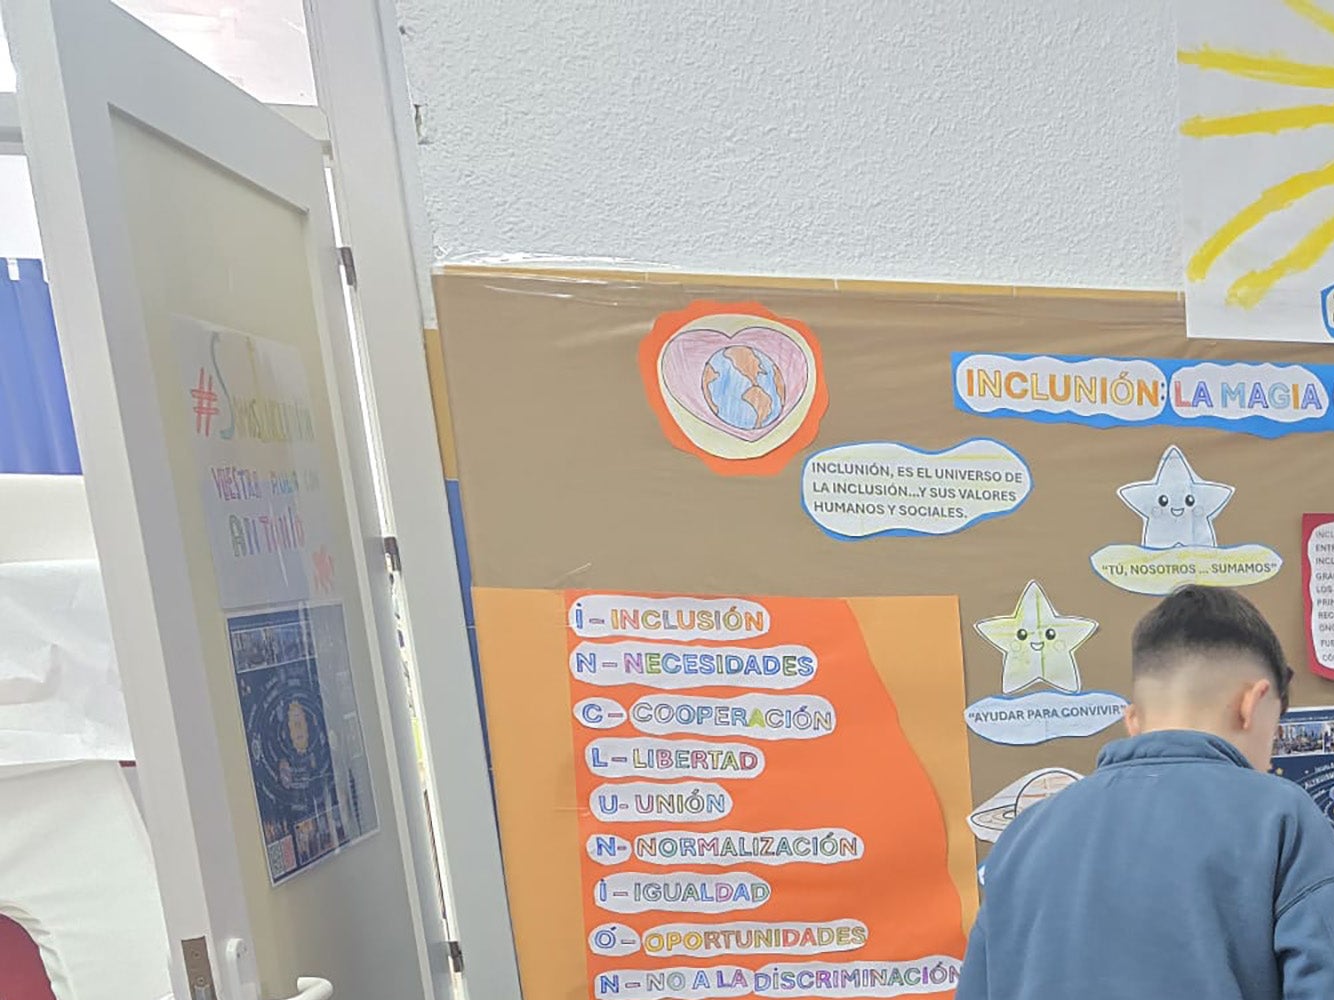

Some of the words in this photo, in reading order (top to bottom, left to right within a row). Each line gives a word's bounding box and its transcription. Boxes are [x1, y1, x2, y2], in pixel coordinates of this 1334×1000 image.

[1175, 381, 1213, 407] LA
[1221, 382, 1322, 410] MAGIA
[812, 462, 893, 478] INCLUNIÓN,
[898, 467, 913, 478] ES
[917, 468, 932, 478] EL
[935, 469, 1001, 481] UNIVERSO
[1005, 472, 1022, 483] DE
[813, 482, 829, 493] LA
[930, 488, 955, 498] SUS
[959, 489, 1016, 501] VALORES
[814, 501, 885, 514] HUMANOS
[888, 506, 896, 515] Y
[899, 506, 967, 518] SOCIALES.
[1131, 564, 1196, 574] NOSOTROS
[611, 606, 764, 631] INCLUSIÓN
[576, 653, 595, 673] N
[624, 653, 814, 676] NECESIDADES
[582, 704, 603, 723] C
[633, 702, 832, 731] COOPERACIÓN
[1028, 708, 1058, 718] PARA
[591, 748, 607, 767] L
[633, 748, 757, 770] LIBERTAD
[635, 789, 725, 813] UNIÓN
[637, 832, 857, 858] NORMALIZACIÓN
[634, 882, 769, 902] IGUALDAD
[595, 926, 616, 948] Ó
[644, 926, 866, 951] OPORTUNIDADES
[600, 976, 619, 994] N
[647, 972, 686, 991] NO
[693, 970, 710, 989] A
[716, 967, 748, 988] LA
